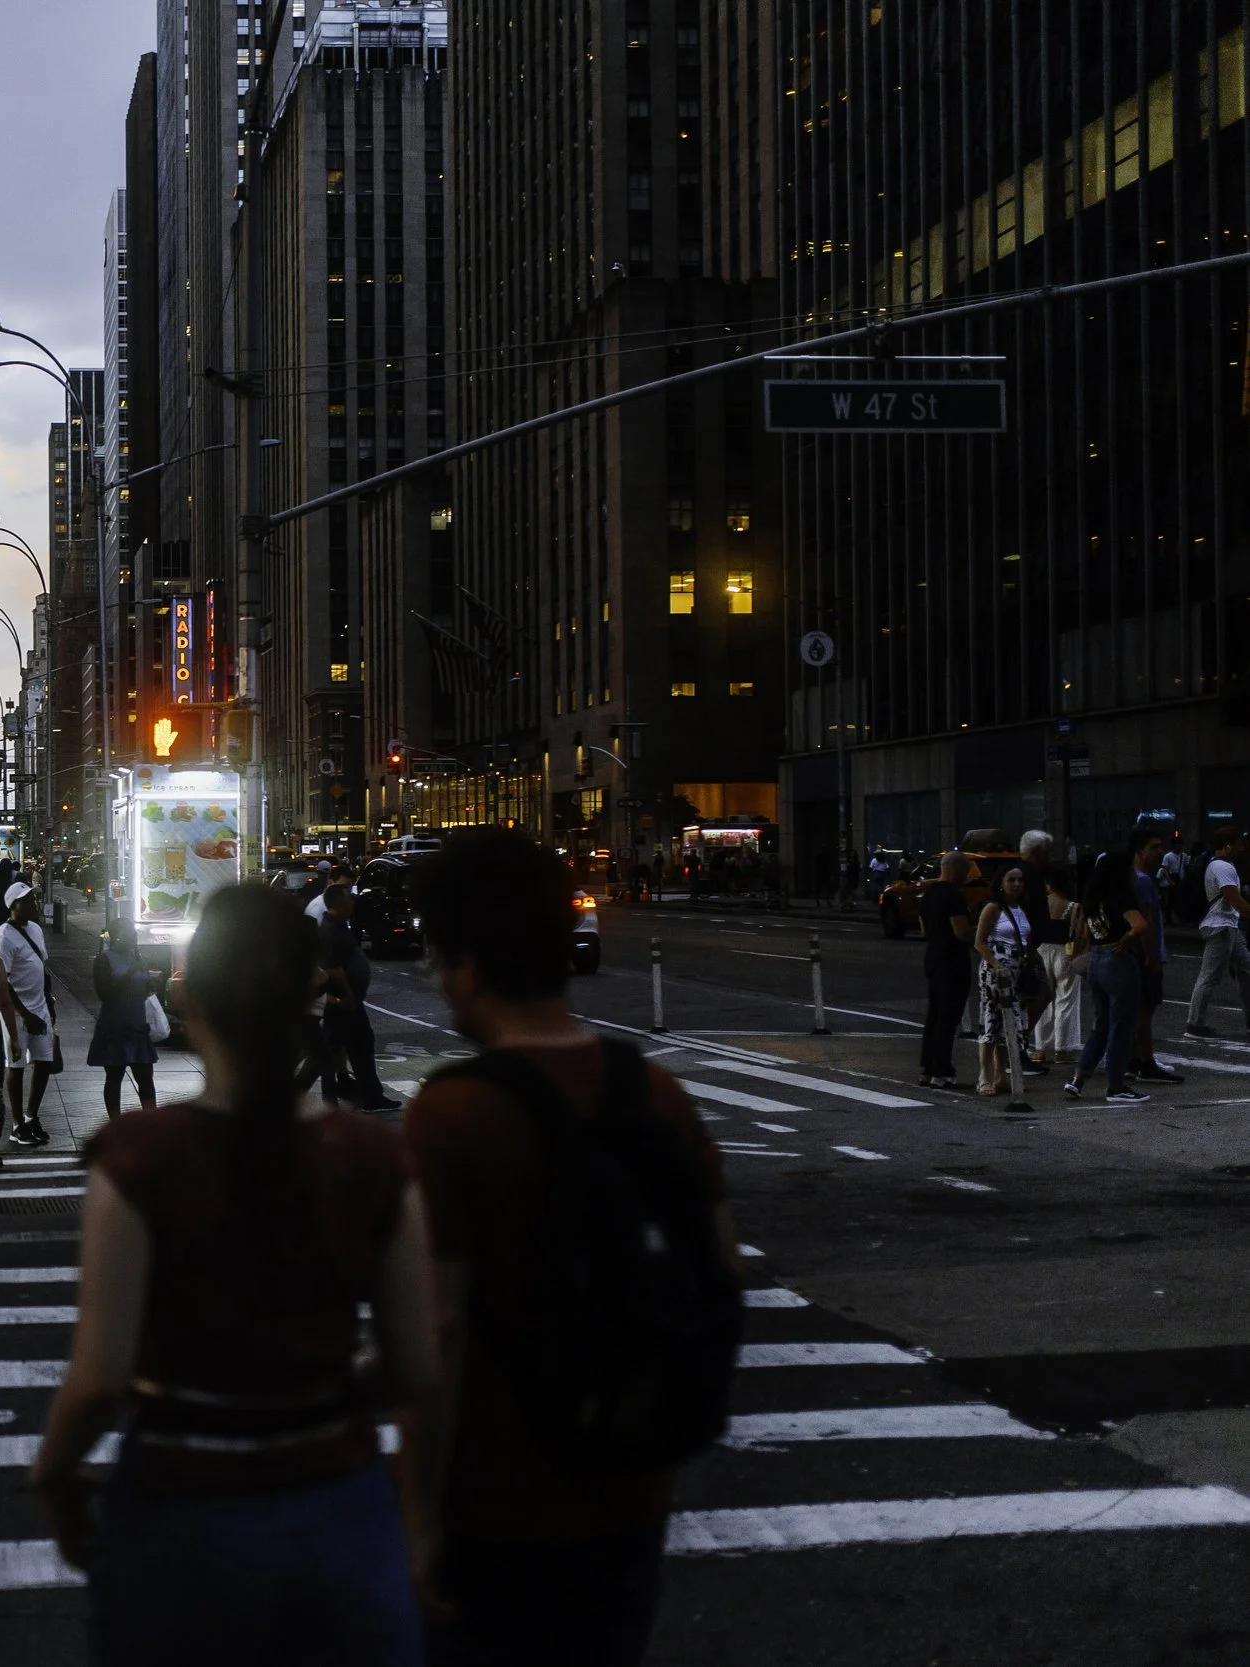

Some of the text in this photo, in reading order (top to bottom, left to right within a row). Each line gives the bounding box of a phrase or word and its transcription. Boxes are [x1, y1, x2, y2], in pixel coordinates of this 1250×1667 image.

[831, 392, 938, 421] W 47 St
[176, 604, 190, 680] RADIO
